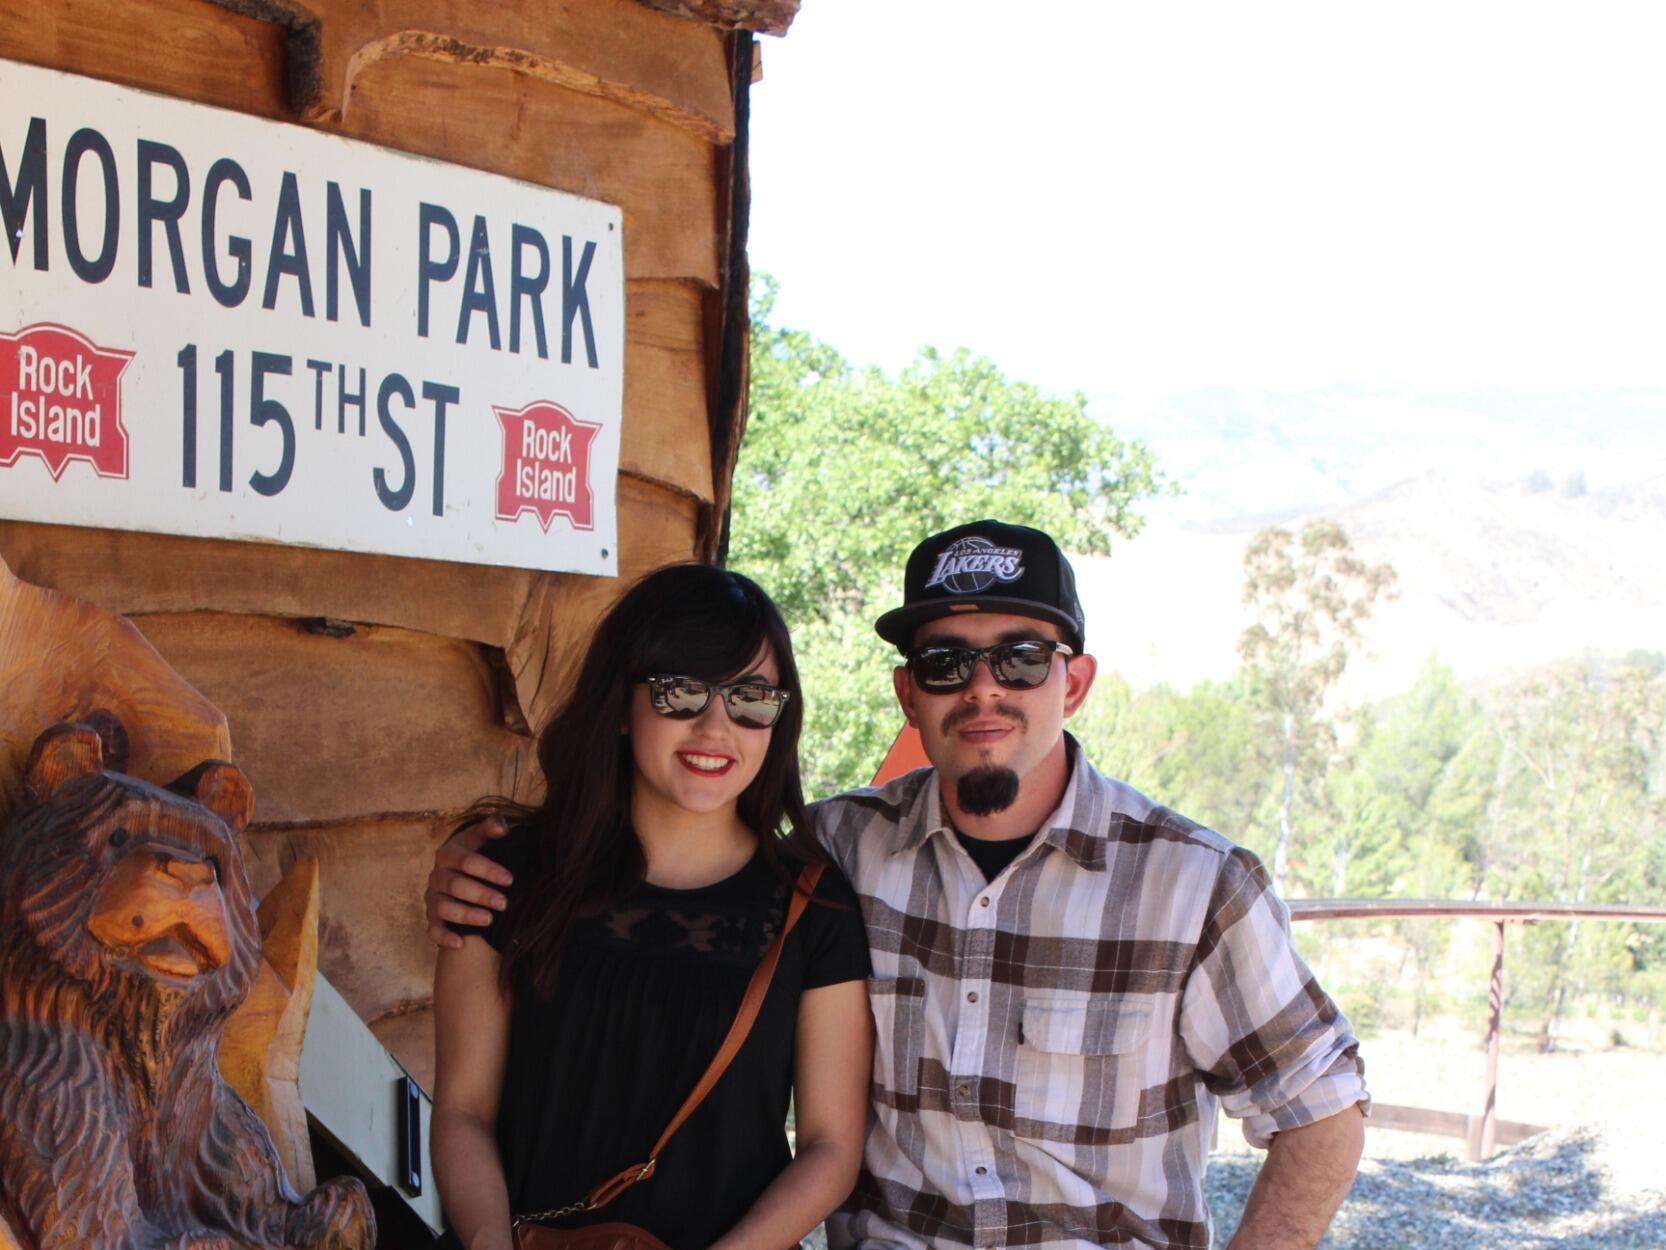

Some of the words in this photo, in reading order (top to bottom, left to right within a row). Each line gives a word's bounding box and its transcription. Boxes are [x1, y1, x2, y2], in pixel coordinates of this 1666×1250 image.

[0, 116, 373, 328] MORGAN
[417, 201, 600, 370] PARK
[19, 345, 94, 401] Rock
[11, 391, 101, 447] Island
[522, 419, 573, 465] Rock
[515, 458, 577, 504] Island
[925, 551, 1025, 588] LAKERS
